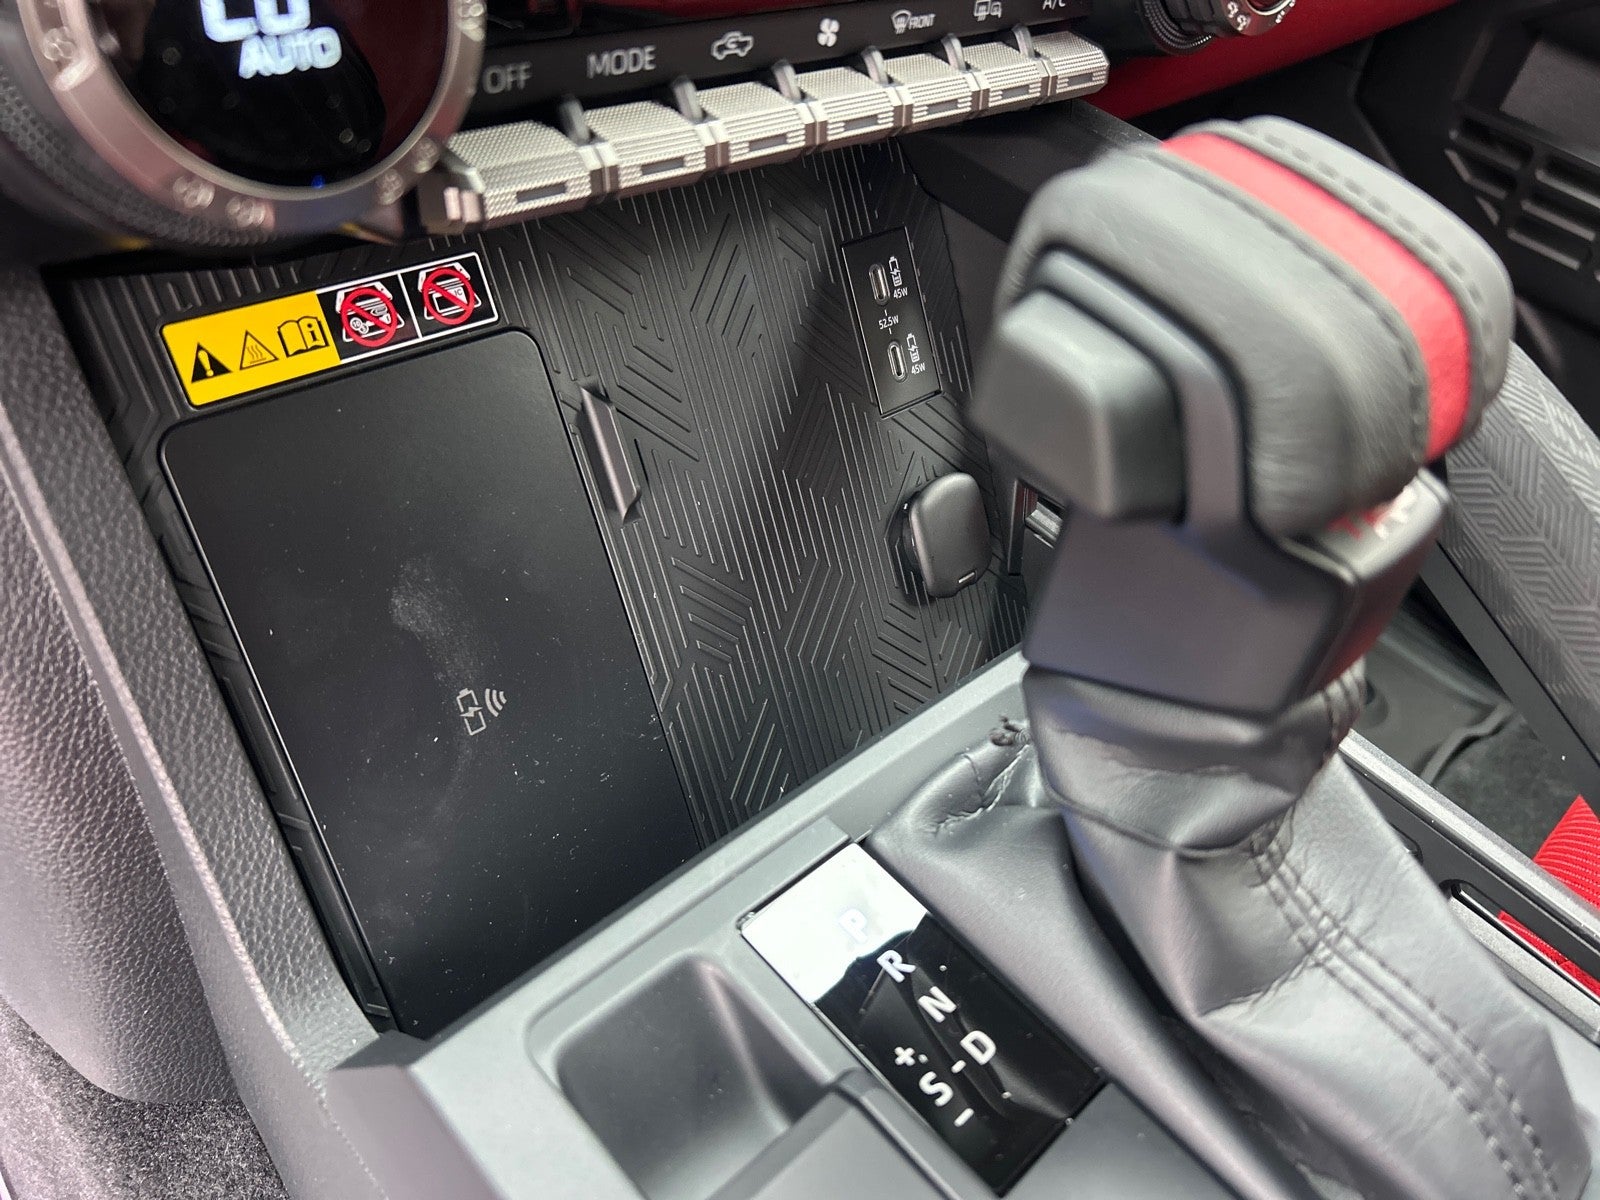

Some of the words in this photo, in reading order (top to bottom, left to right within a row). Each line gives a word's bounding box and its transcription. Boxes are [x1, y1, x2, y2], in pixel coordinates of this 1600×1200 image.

[909, 13, 936, 30] FRONT
[239, 26, 342, 79] AUTO
[587, 45, 656, 79] MODE
[482, 61, 532, 94] OFF
[893, 287, 908, 299] 45W
[878, 315, 899, 330] 52.5W
[911, 362, 926, 375] 45W
[839, 908, 868, 944] P
[876, 949, 916, 983] R
[918, 986, 957, 1022] N
[960, 1030, 996, 1065] D
[919, 1071, 953, 1107] S
